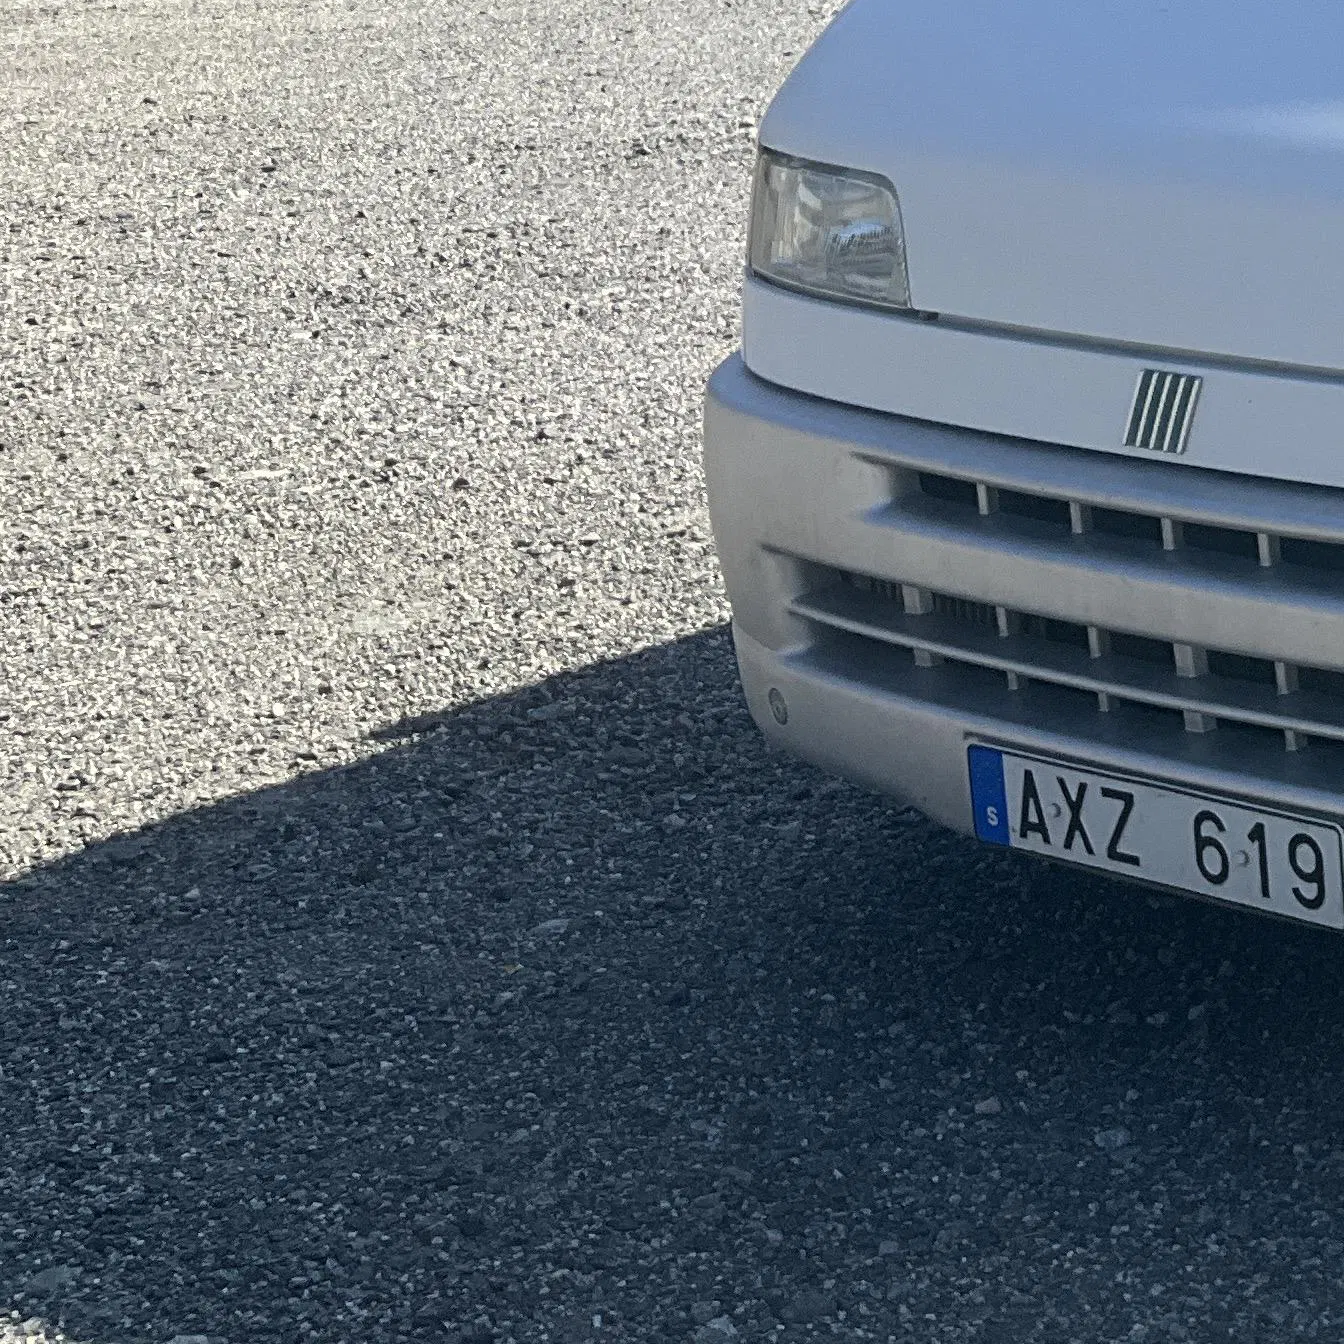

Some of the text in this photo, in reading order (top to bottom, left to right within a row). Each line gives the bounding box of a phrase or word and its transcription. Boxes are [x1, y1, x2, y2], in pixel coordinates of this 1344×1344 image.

[986, 805, 999, 827] S
[1018, 768, 1326, 911] AXZ 619
